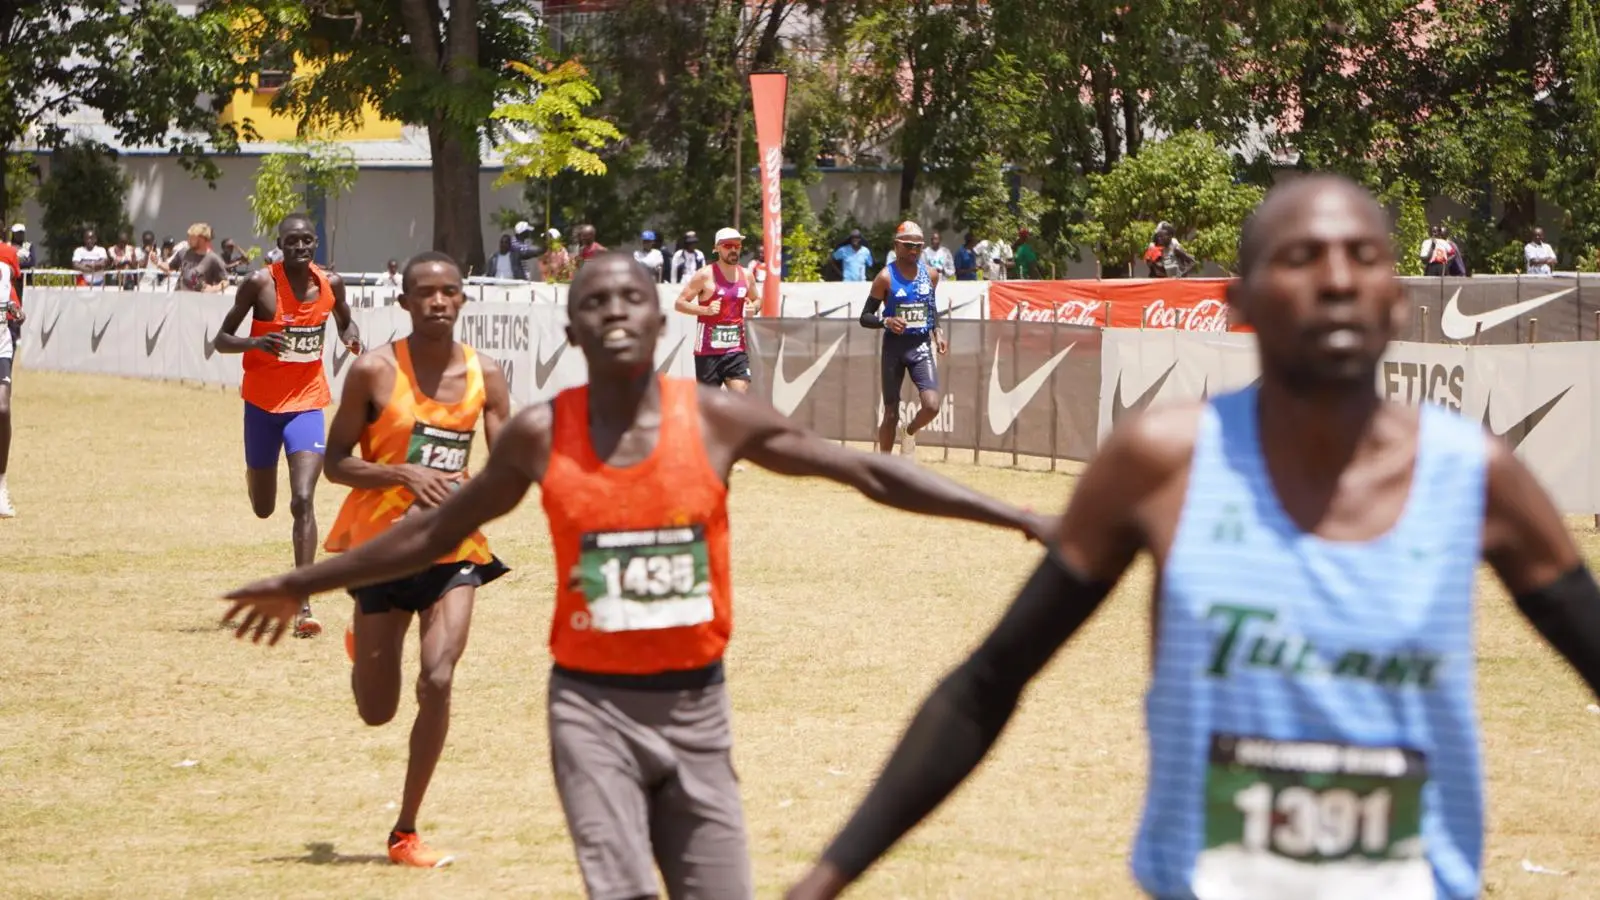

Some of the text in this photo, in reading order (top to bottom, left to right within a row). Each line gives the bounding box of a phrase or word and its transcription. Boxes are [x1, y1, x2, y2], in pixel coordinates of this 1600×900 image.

[288, 335, 321, 351] 1433
[461, 315, 529, 351] ATHLETICS
[599, 554, 695, 598] 1435
[1233, 782, 1393, 856] 1391
